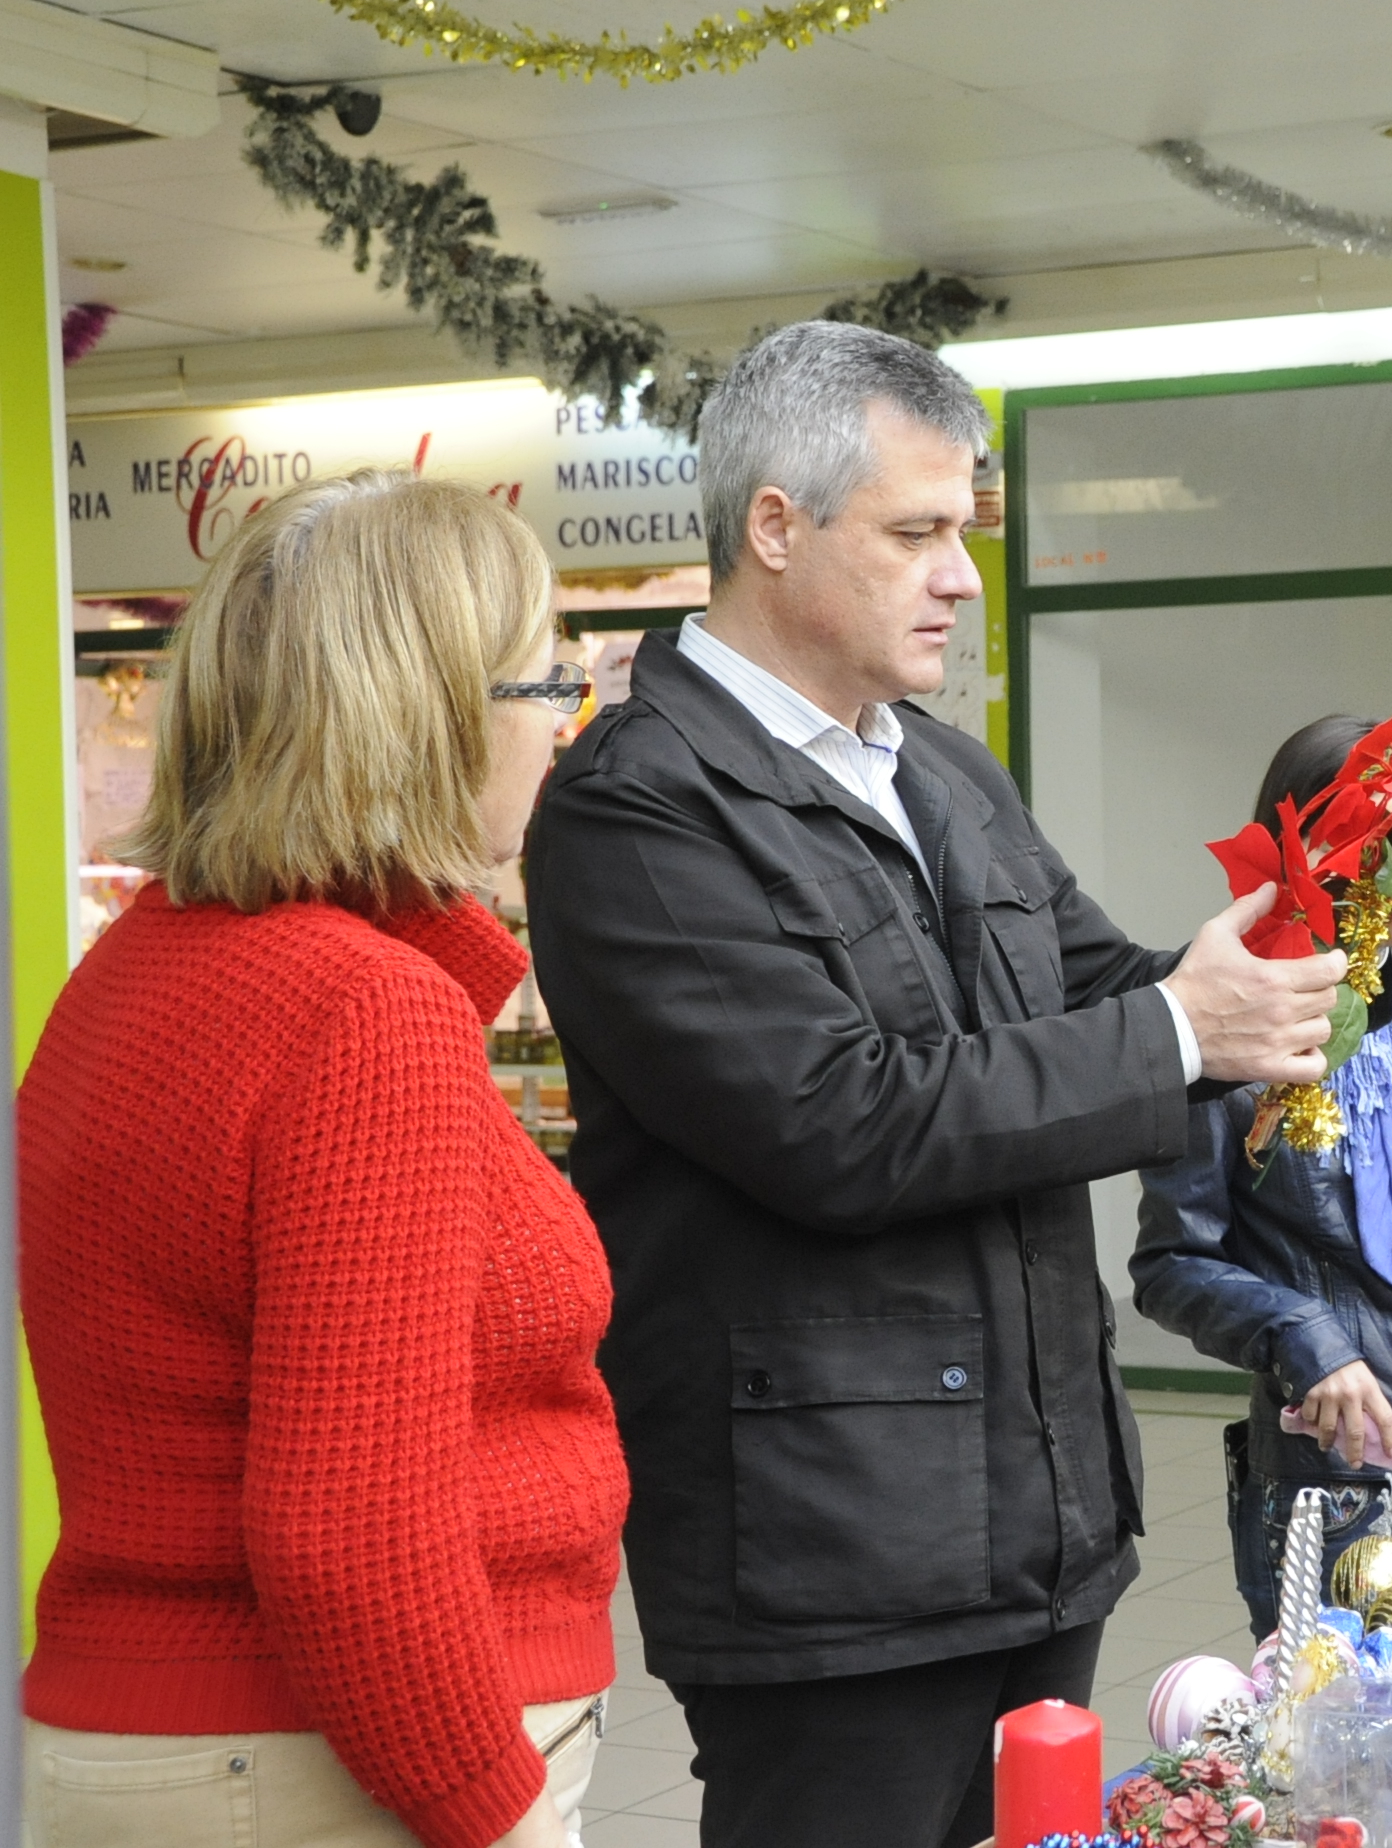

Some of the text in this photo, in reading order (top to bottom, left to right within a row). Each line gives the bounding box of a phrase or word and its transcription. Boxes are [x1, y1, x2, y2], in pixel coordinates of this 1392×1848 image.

[132, 452, 311, 494] MERCADITO
[557, 453, 697, 491] MARISCO
[558, 512, 702, 548] CONGELA
